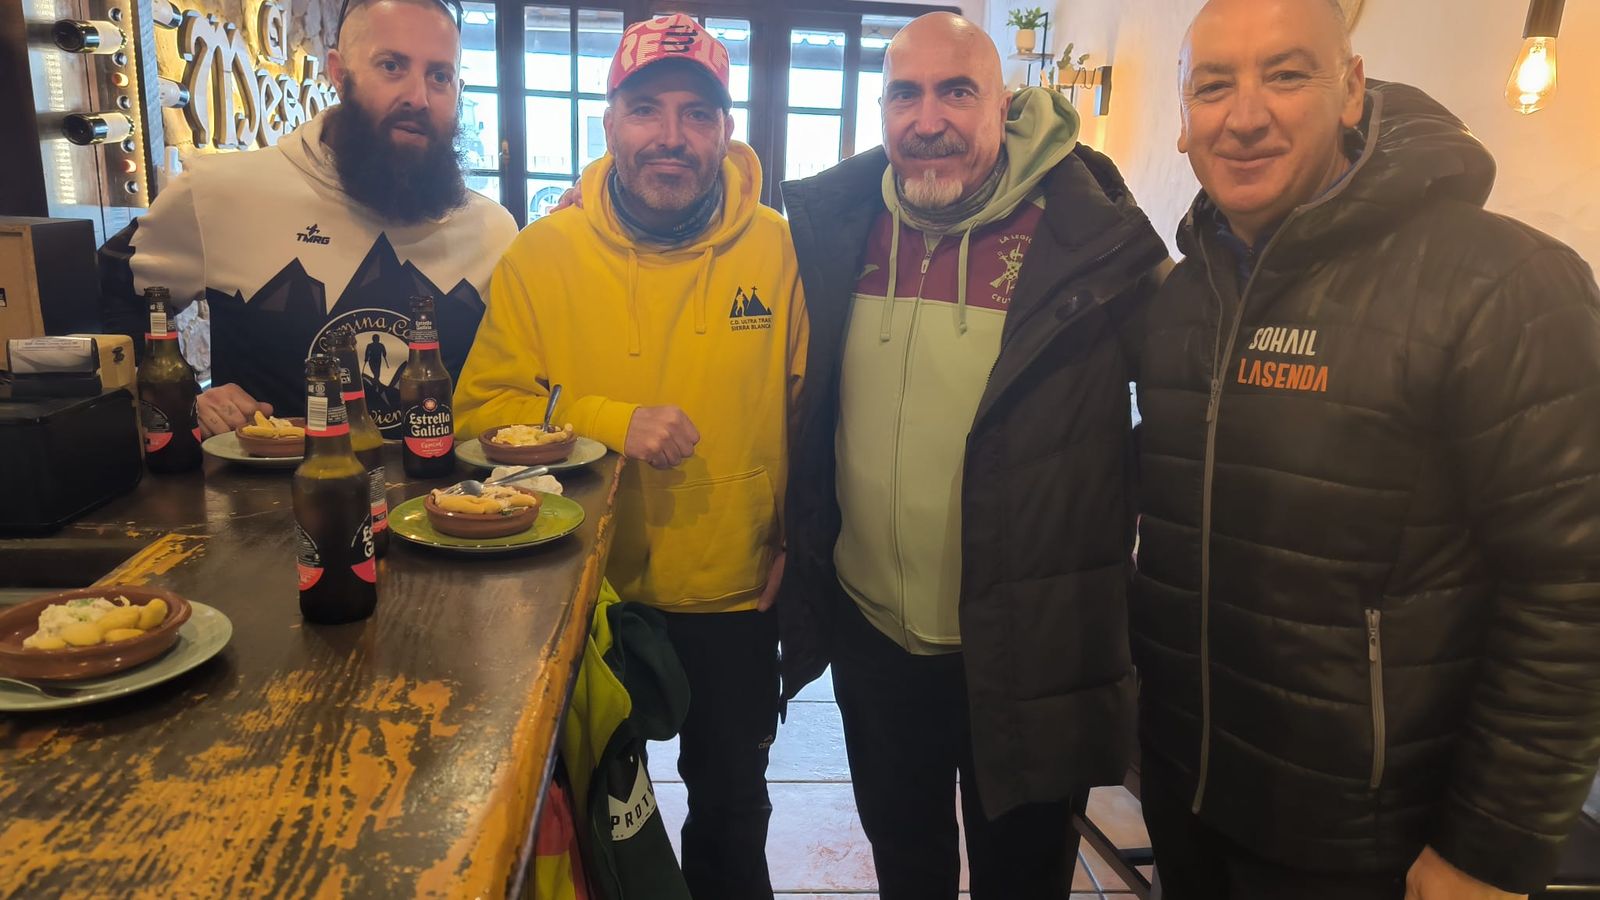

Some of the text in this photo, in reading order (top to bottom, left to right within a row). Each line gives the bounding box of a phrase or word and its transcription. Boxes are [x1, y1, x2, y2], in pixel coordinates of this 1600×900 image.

[296, 232, 331, 245] TMRG
[999, 234, 1032, 244] LA LEGI
[1248, 326, 1317, 356] SOHAIL
[1237, 358, 1329, 392] LASENDA
[409, 412, 450, 425] Estrella
[411, 424, 449, 437] Galicia
